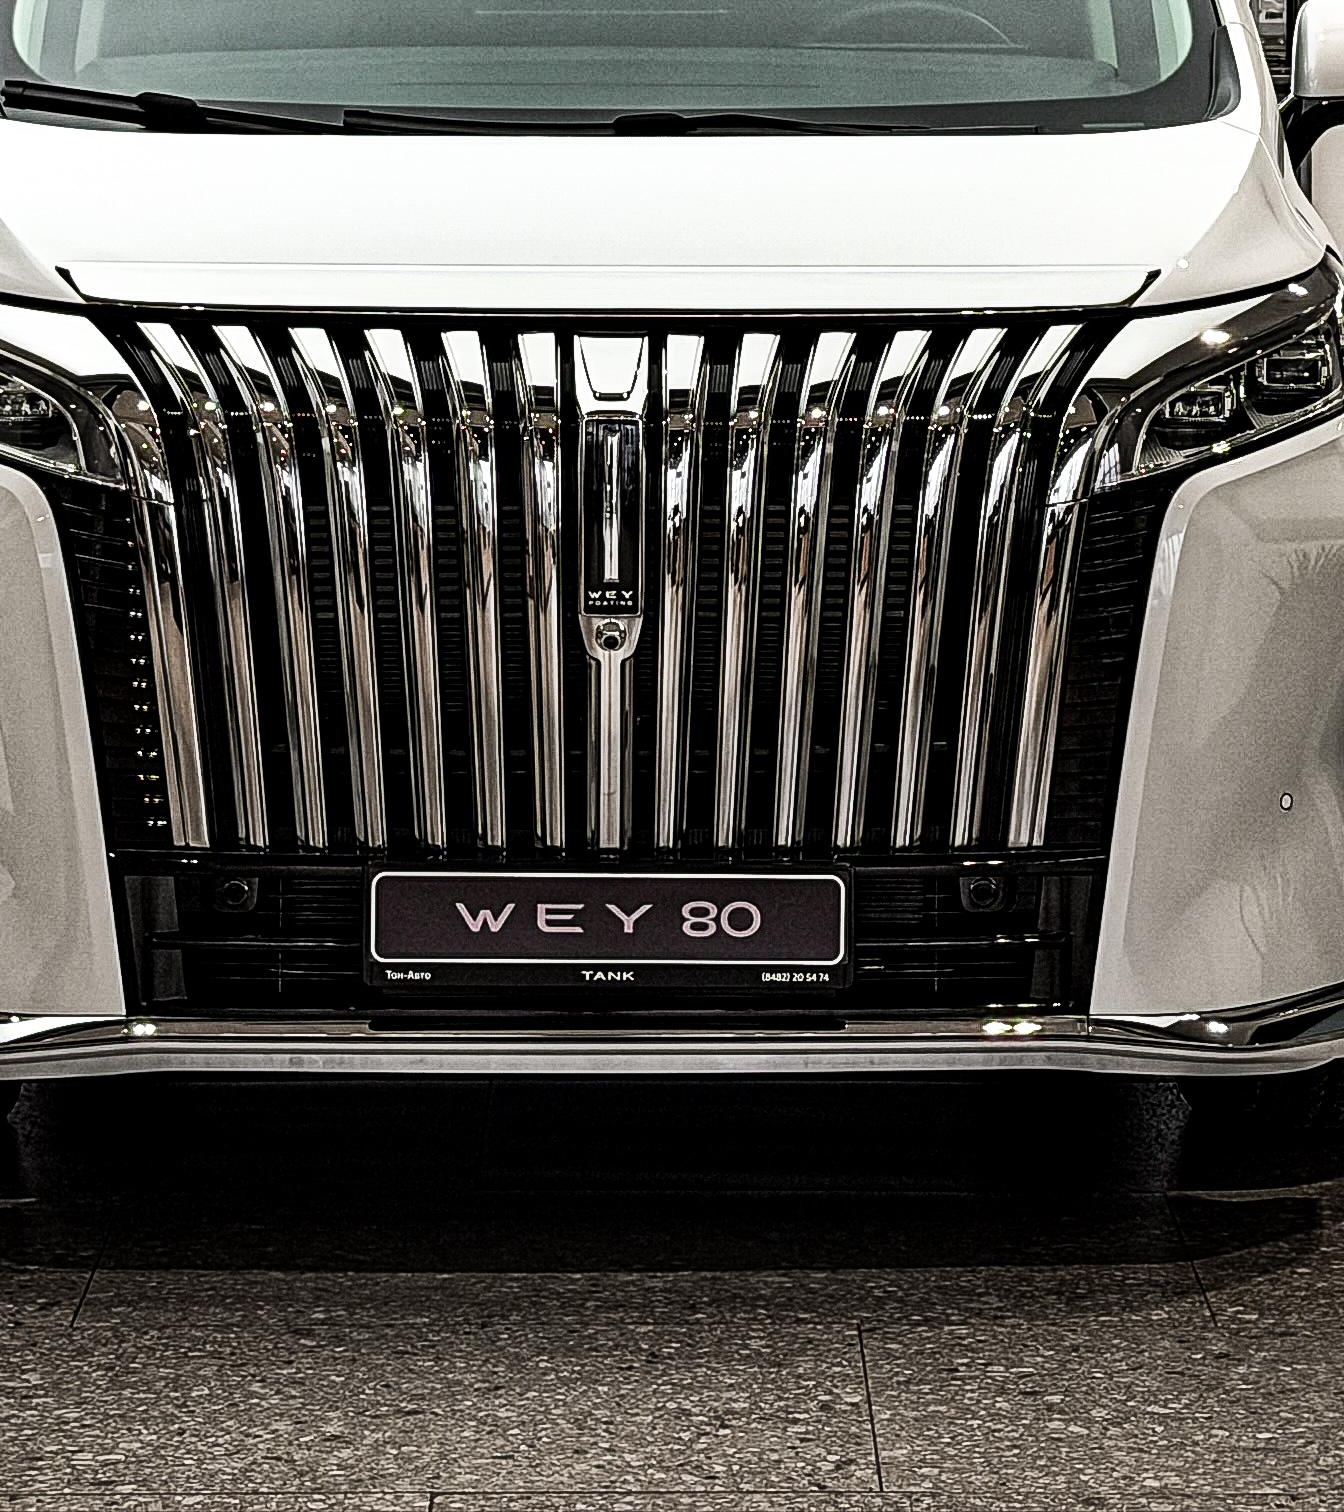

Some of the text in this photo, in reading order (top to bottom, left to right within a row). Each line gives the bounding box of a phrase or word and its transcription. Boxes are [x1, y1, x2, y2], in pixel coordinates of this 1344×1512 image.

[588, 590, 633, 599] WEY
[455, 900, 762, 938] WEY 80
[385, 970, 432, 981] Тон-Авто
[581, 970, 635, 981] TANK
[792, 972, 804, 982] 20
[805, 972, 817, 982] 54
[818, 972, 830, 982] 74
